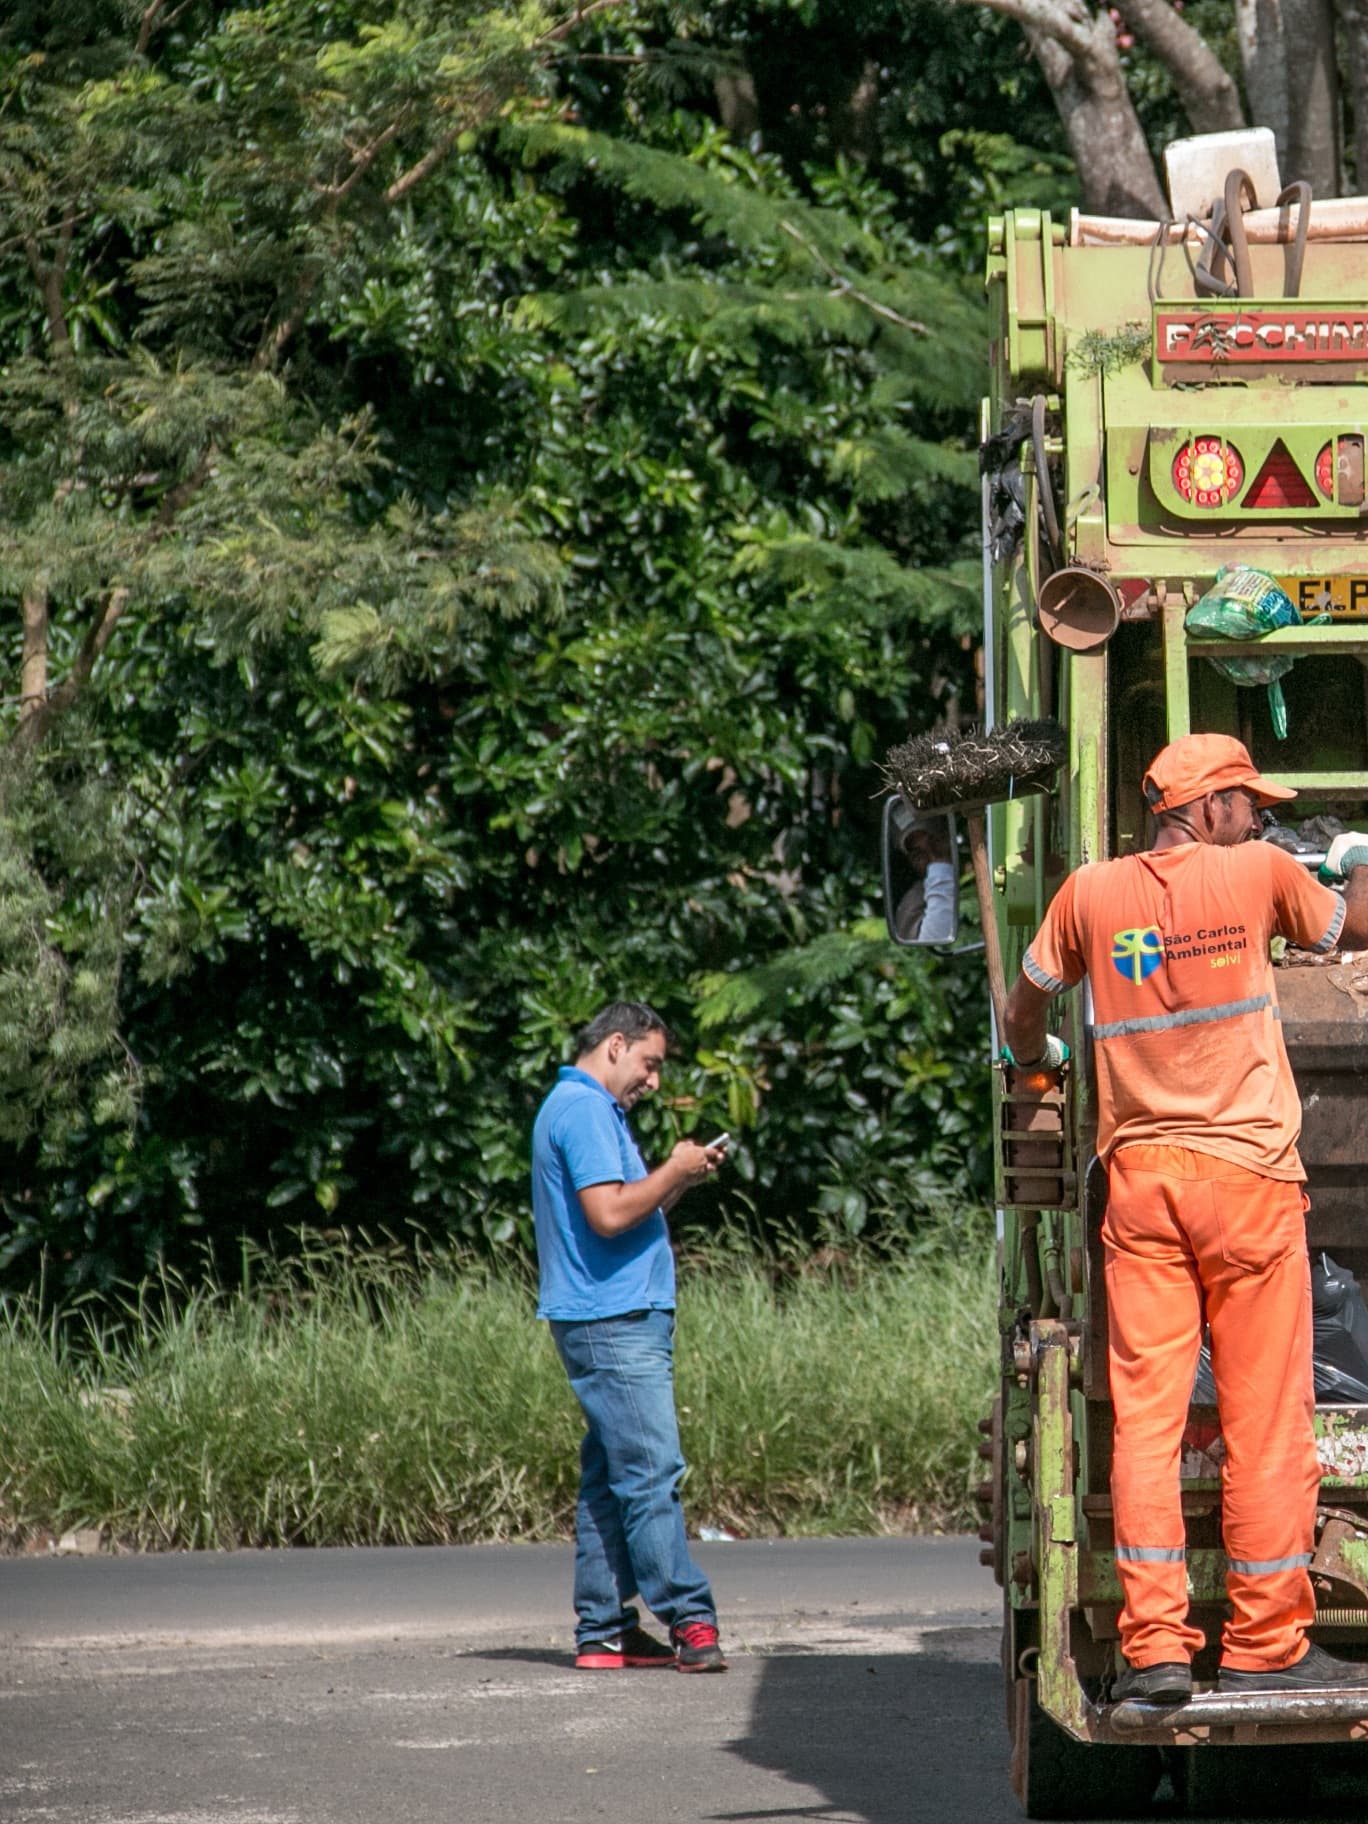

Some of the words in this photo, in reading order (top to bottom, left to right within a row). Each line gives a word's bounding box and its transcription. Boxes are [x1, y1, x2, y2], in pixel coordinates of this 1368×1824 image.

[1164, 934, 1191, 946] São
[1197, 924, 1246, 940] Carlos
[1165, 938, 1247, 961] Ambiental
